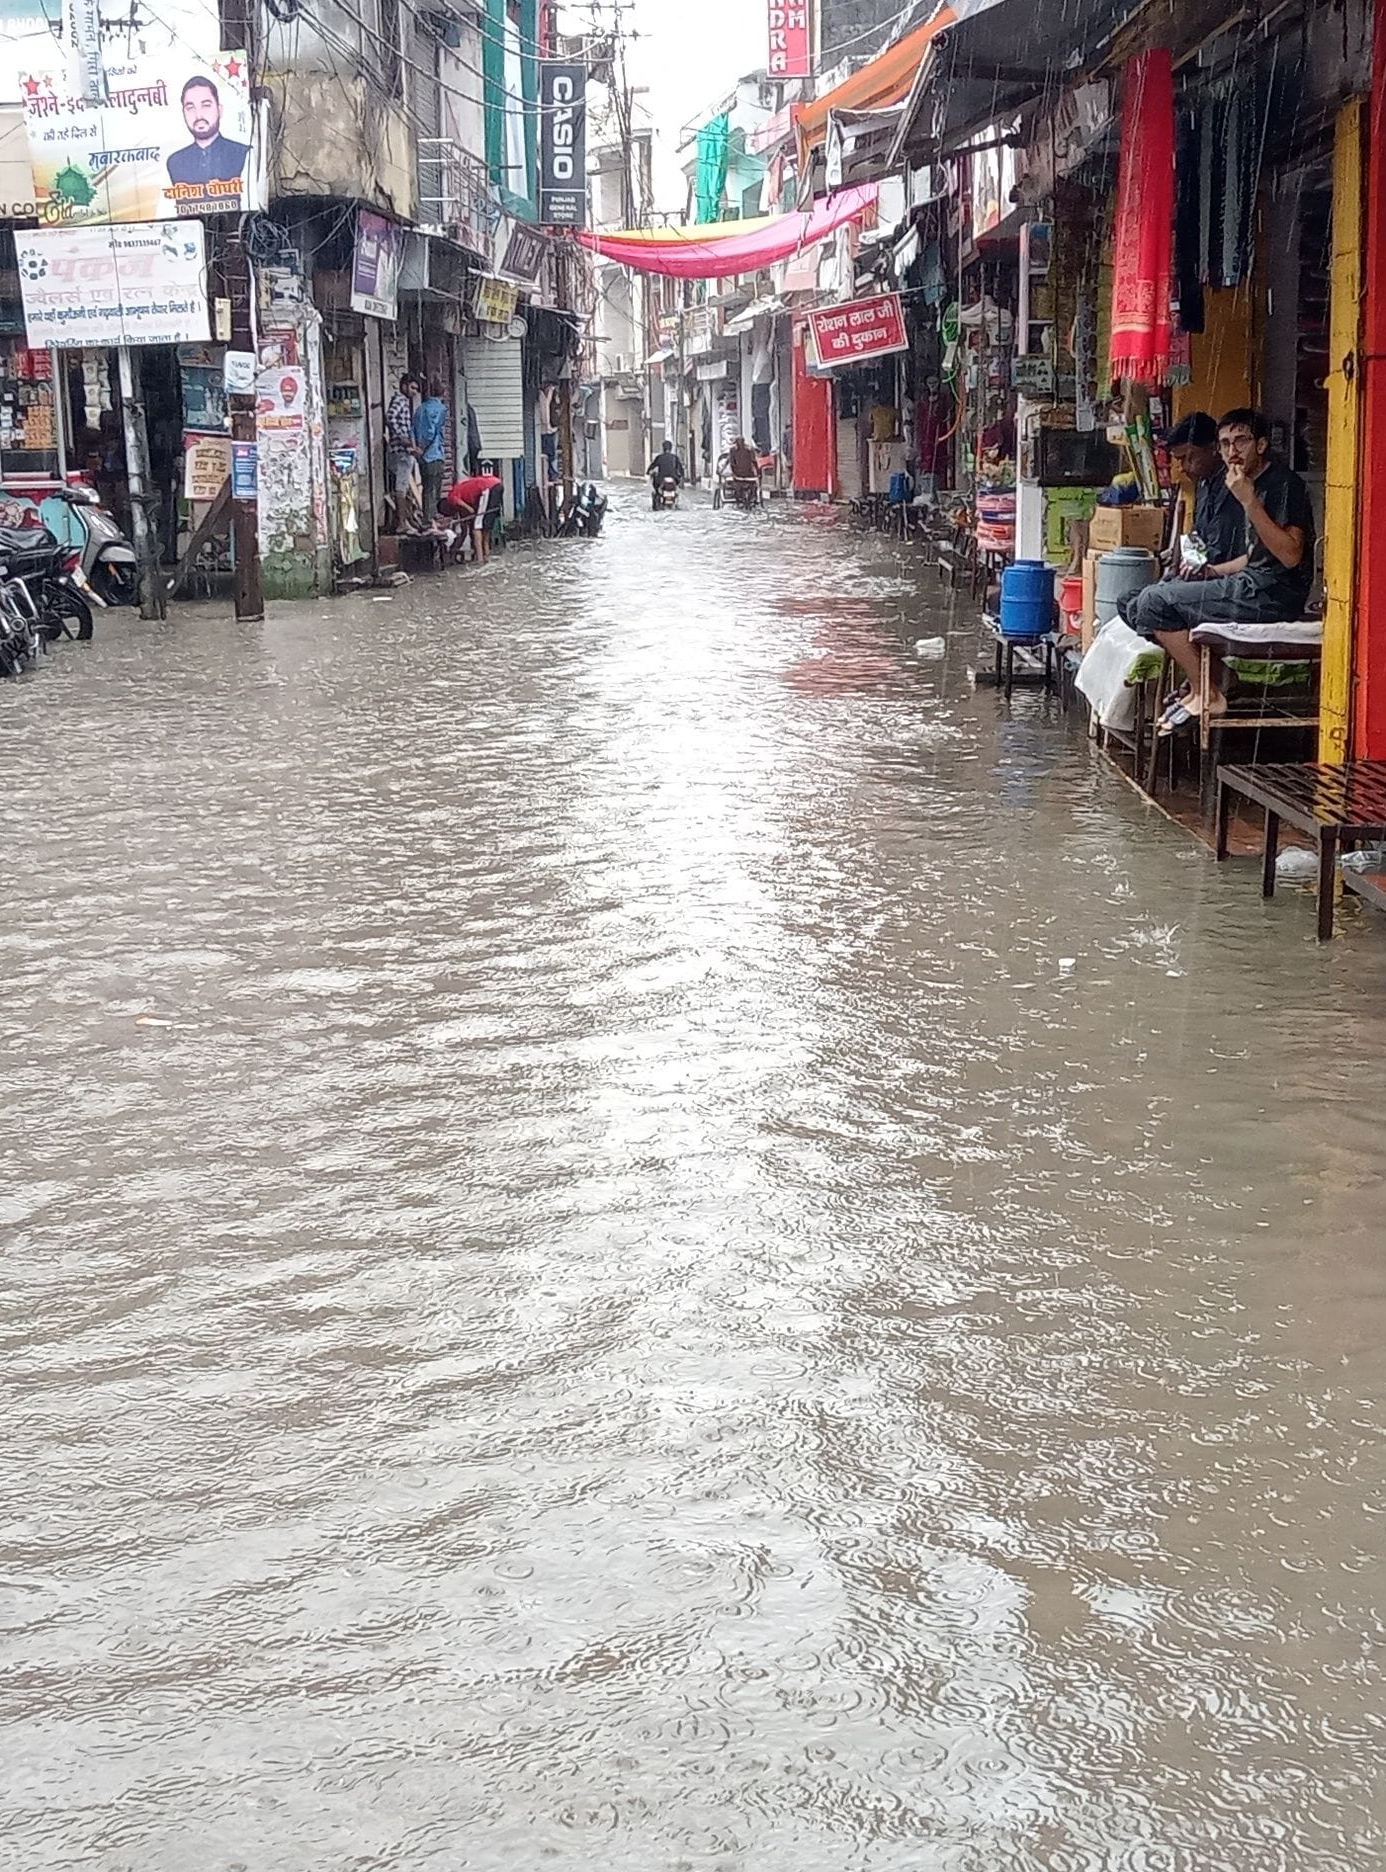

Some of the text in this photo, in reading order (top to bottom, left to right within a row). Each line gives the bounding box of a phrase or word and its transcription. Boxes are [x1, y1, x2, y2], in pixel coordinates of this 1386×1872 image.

[552, 76, 574, 180] CASIO
[12, 203, 34, 216] CO
[817, 300, 893, 333] रोशन लाल जी
[831, 327, 888, 350] की दुकान
